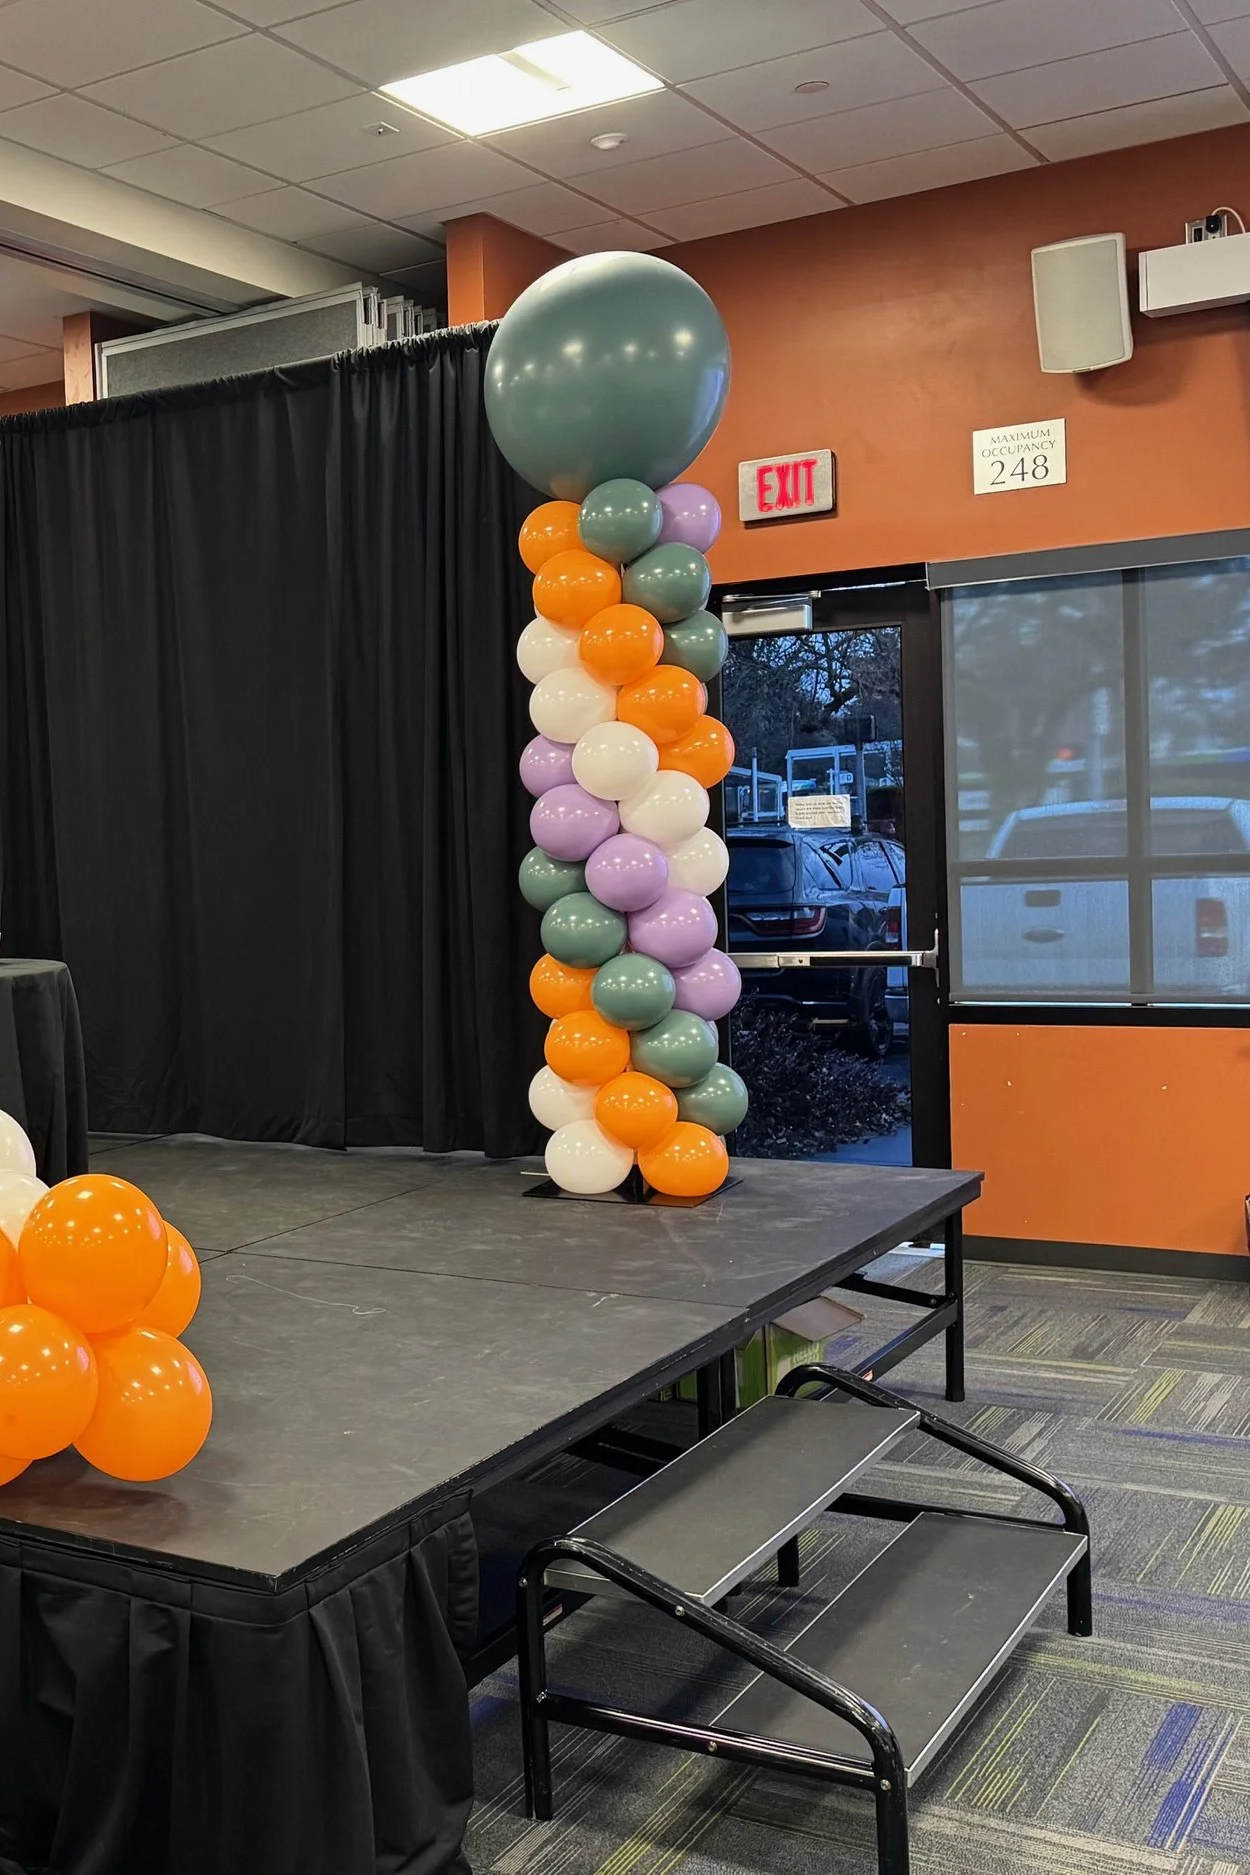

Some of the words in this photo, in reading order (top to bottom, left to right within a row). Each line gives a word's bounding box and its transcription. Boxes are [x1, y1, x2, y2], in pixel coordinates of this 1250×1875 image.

[981, 440, 1056, 458] OCCUPANCY
[990, 428, 1051, 445] MAXIMUM
[990, 454, 1049, 486] 248
[756, 458, 817, 513] EXIT
